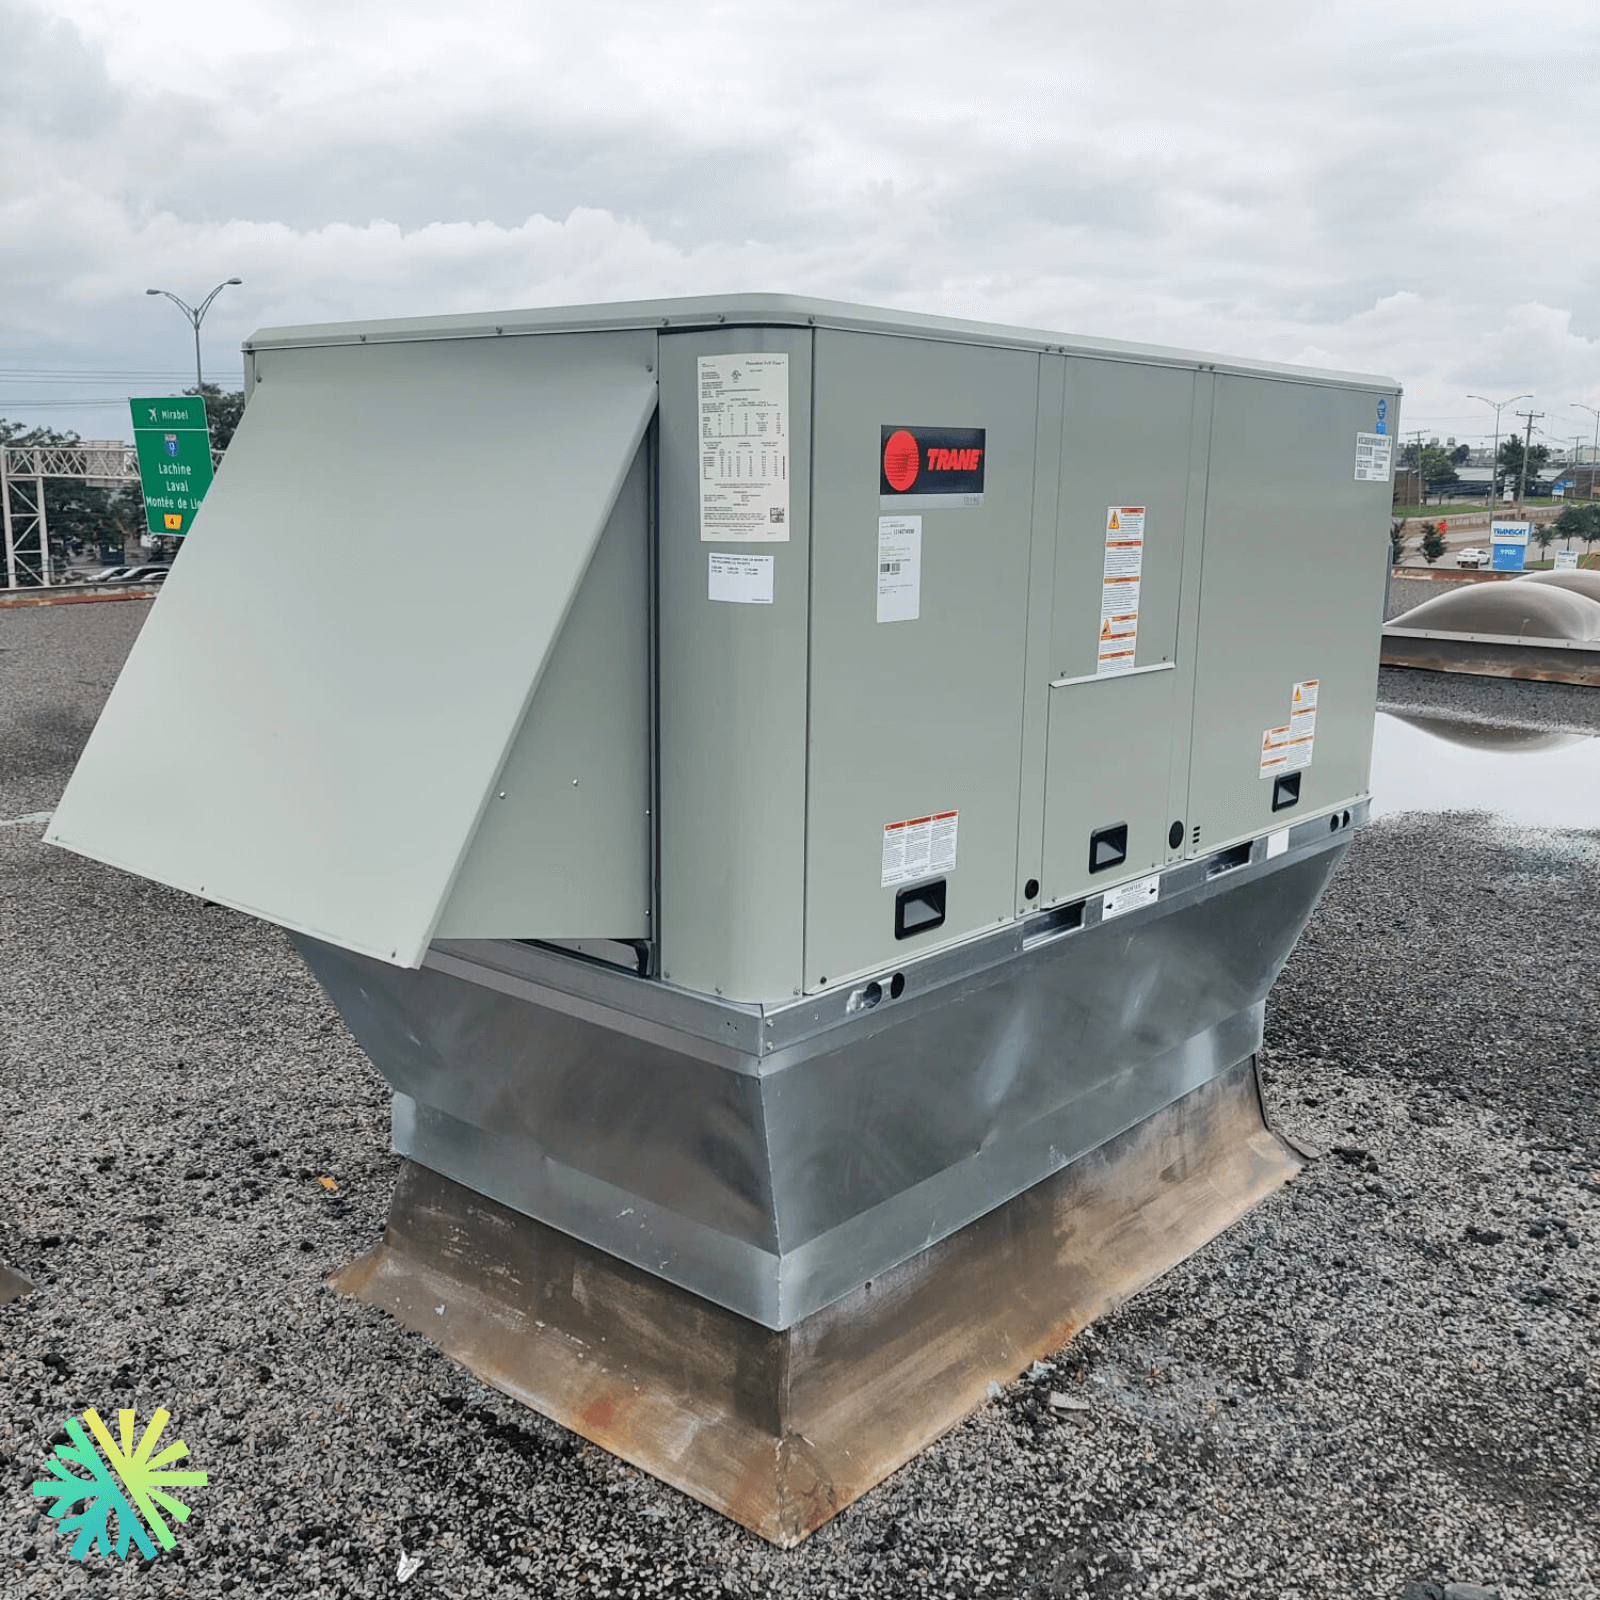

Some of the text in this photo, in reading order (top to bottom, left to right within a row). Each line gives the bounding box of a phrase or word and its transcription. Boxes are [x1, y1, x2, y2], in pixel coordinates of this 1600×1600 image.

[161, 410, 188, 420] Mirabel
[927, 448, 981, 471] TRANE
[158, 463, 192, 475] Lachine
[166, 480, 189, 492] Laval
[146, 495, 175, 508] Montée
[177, 497, 188, 509] de
[1493, 528, 1527, 536] TRANSCAT
